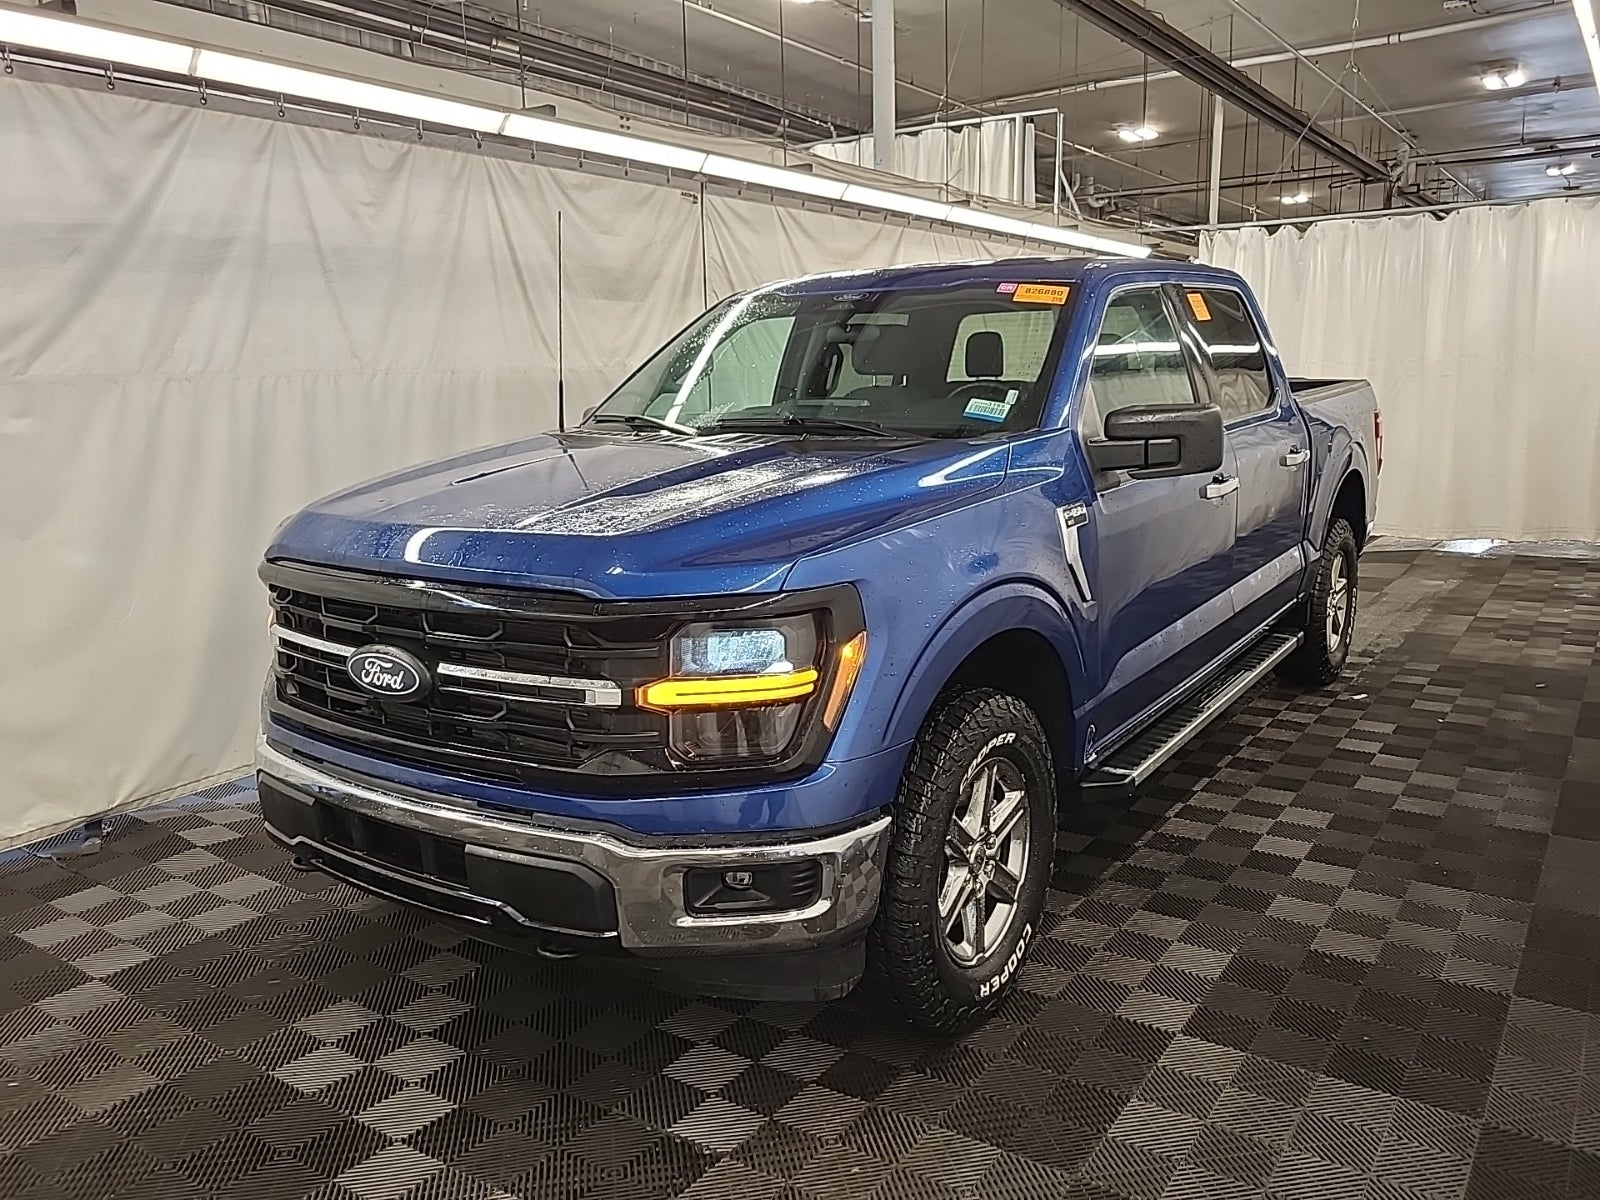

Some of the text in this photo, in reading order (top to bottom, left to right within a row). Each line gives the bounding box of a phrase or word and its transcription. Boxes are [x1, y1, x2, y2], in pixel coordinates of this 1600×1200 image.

[361, 658, 405, 690] Ford
[960, 732, 1017, 795] COOPER
[979, 923, 1032, 999] COOPER
